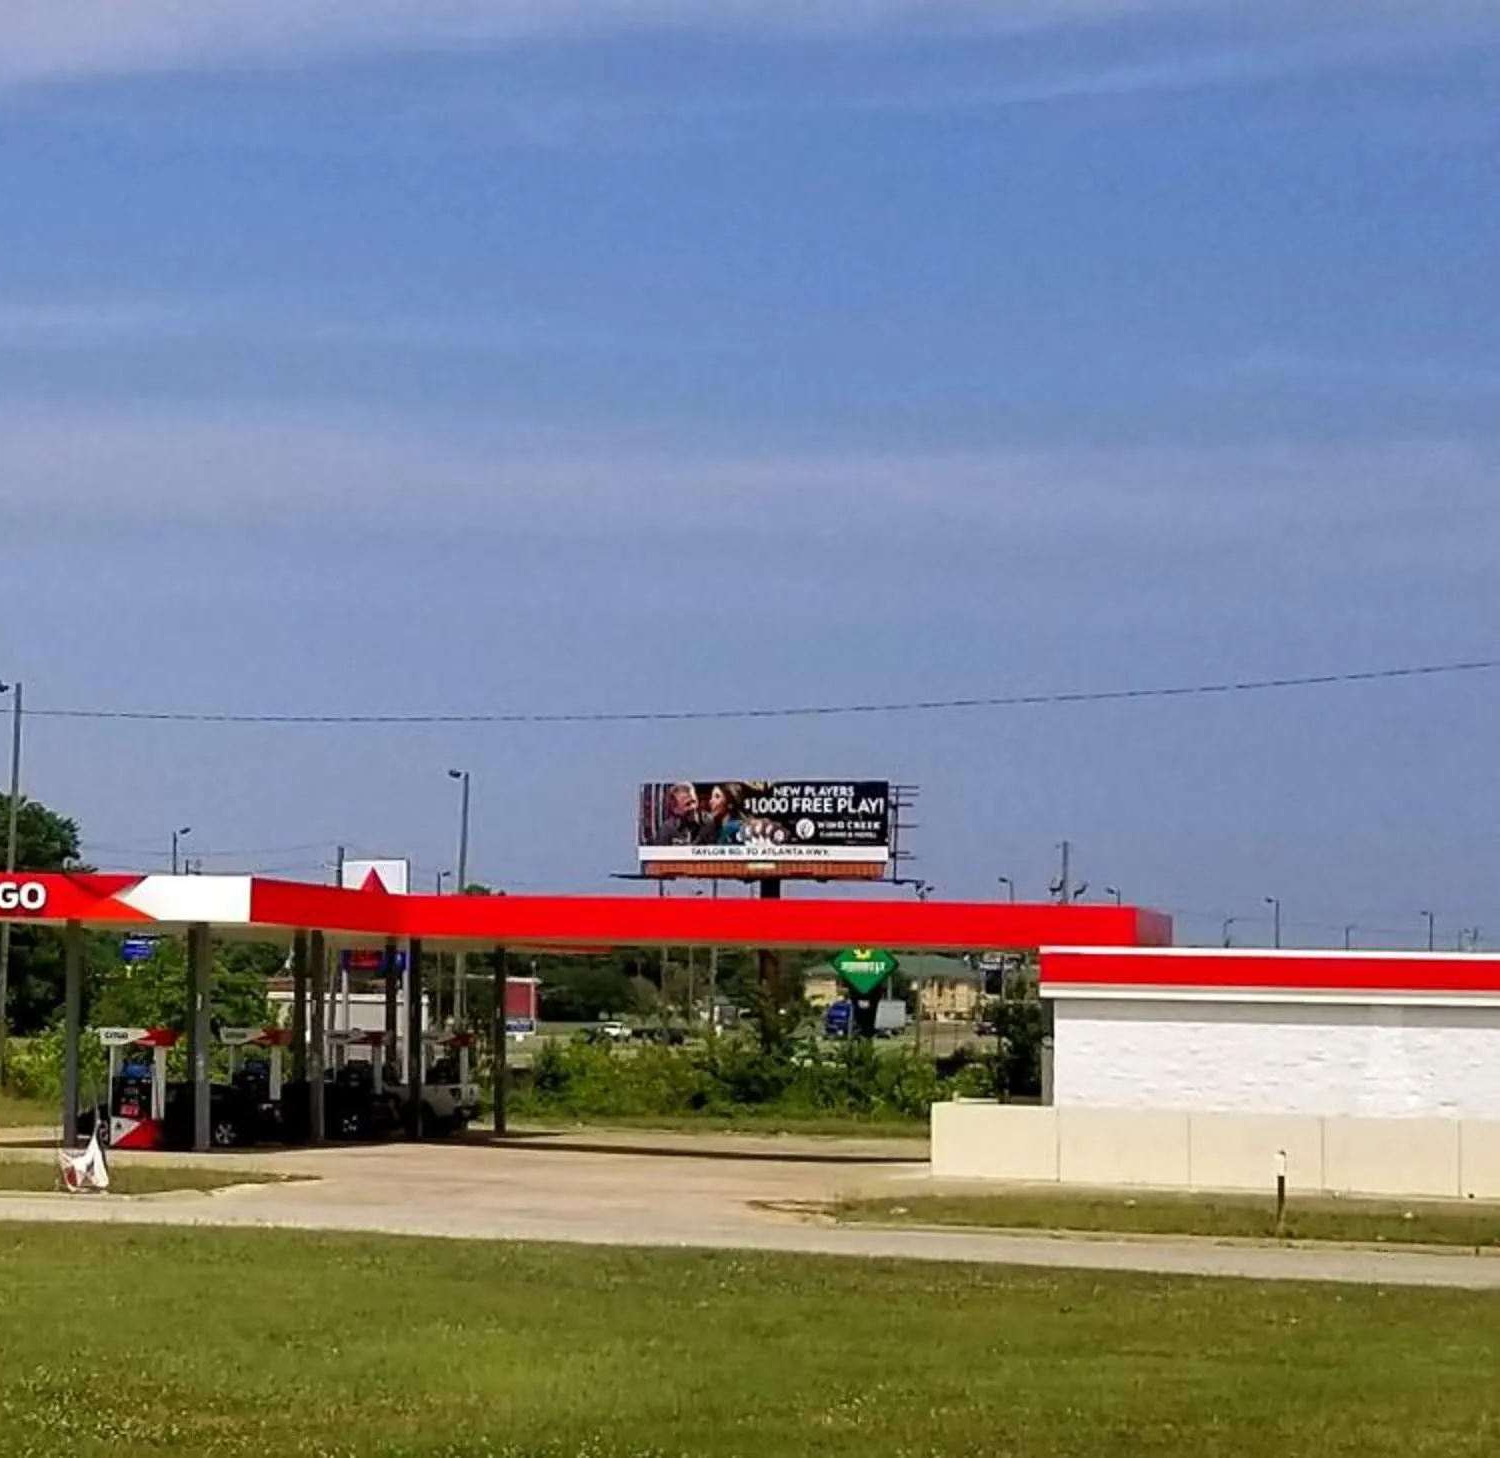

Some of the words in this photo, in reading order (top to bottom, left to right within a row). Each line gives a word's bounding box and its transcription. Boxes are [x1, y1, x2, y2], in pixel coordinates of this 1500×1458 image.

[773, 785, 801, 797] NEW
[803, 785, 855, 797] PLAYERS
[791, 797, 834, 813] FREE
[837, 797, 884, 814] PLAY!
[691, 847, 726, 856] TAYLOR
[761, 847, 802, 856] ATLANTA
